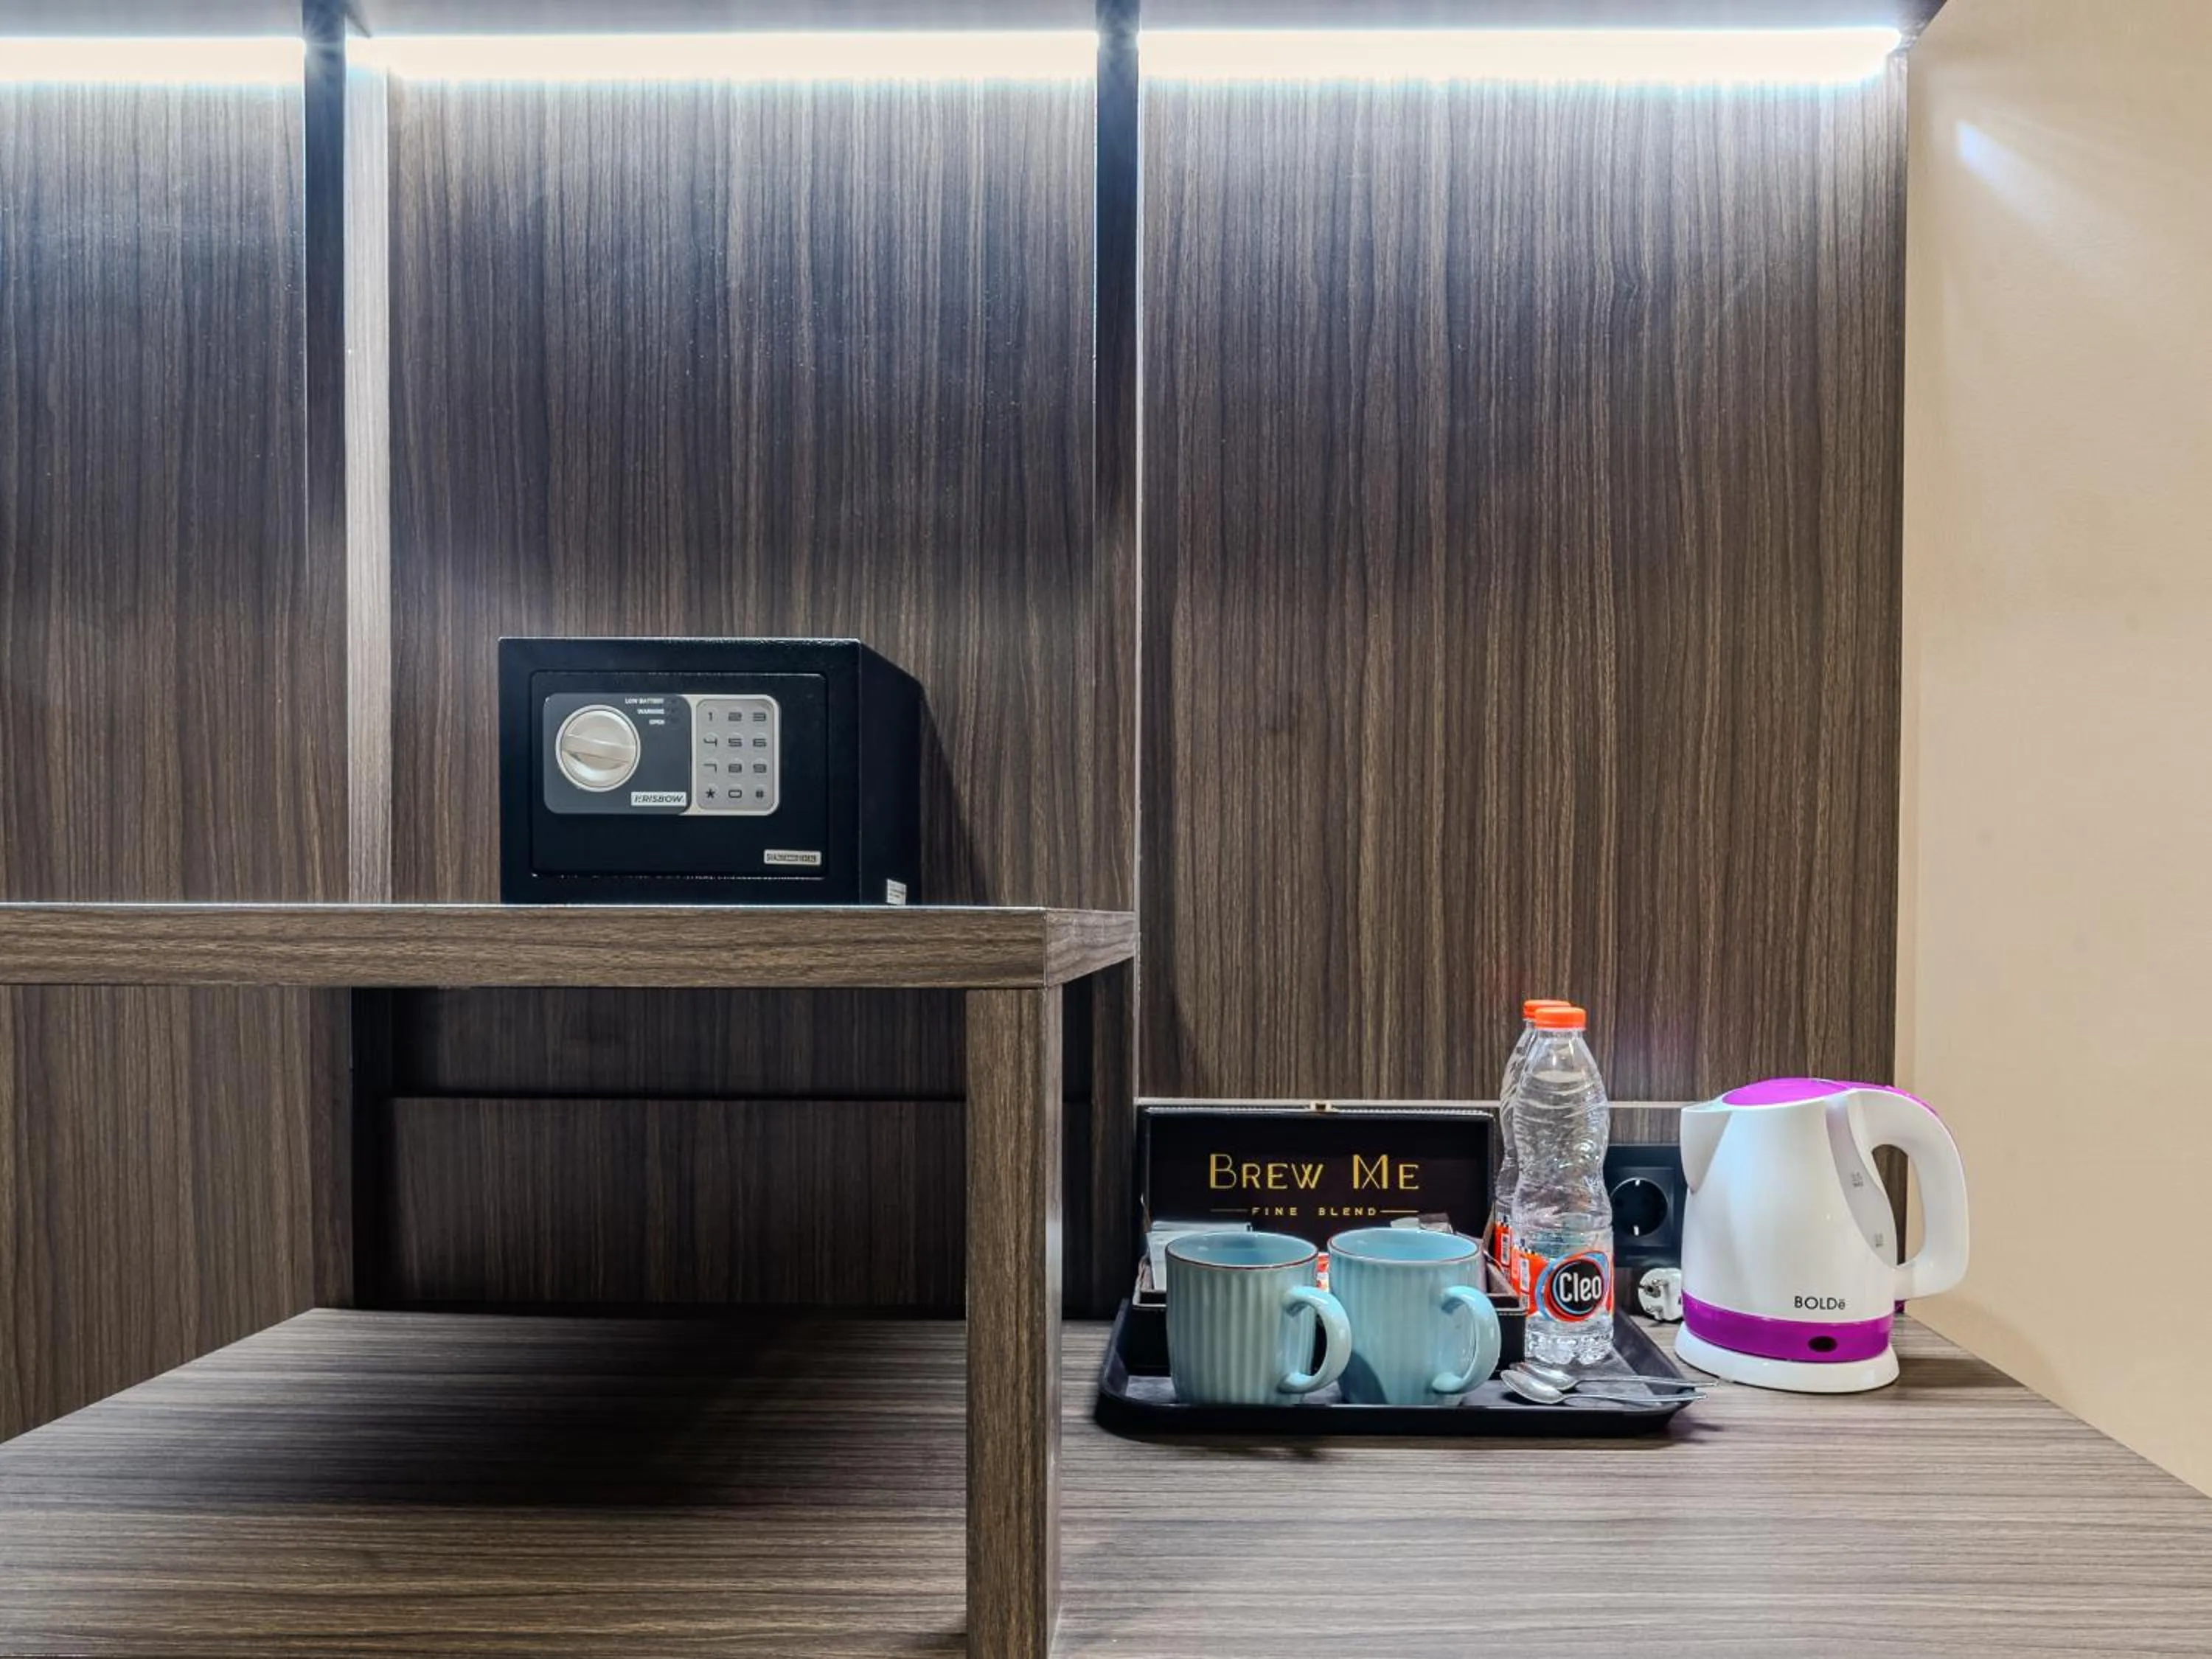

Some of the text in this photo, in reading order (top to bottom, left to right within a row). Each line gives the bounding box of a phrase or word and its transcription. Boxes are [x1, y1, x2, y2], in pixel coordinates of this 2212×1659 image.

[709, 712, 713, 721] 1
[753, 712, 767, 722] 3
[703, 737, 767, 748] 4 5 6
[703, 763, 767, 773] 7 8 9
[1251, 1207, 1377, 1216] FINE BLEND
[1559, 1272, 1602, 1303] Cleo
